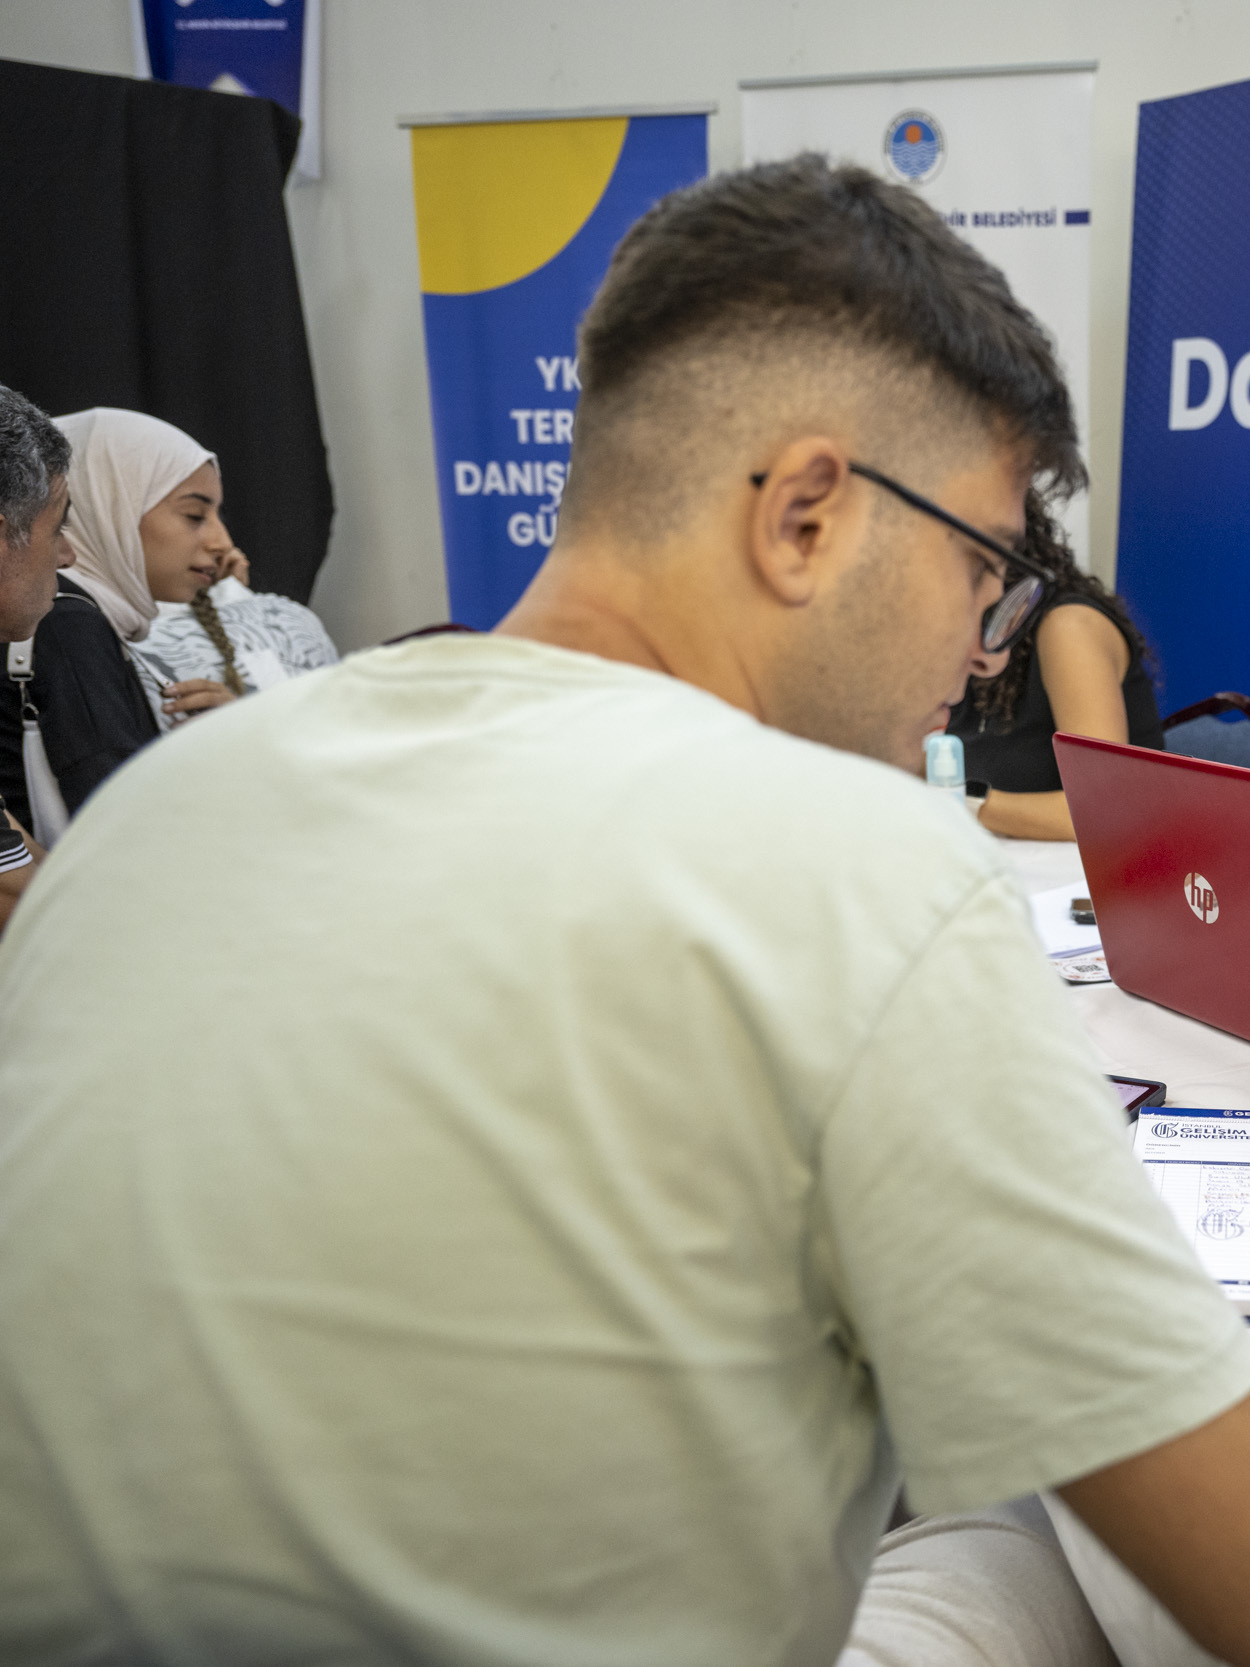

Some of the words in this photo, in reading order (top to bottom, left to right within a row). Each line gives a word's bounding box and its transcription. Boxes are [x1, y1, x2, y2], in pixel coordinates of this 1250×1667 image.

[535, 356, 583, 392] YK
[510, 409, 574, 444] TER
[454, 460, 573, 507] DANIŞ
[507, 504, 558, 547] GÜ
[1191, 872, 1214, 923] hp
[1180, 1127, 1247, 1136] GELİŞİM
